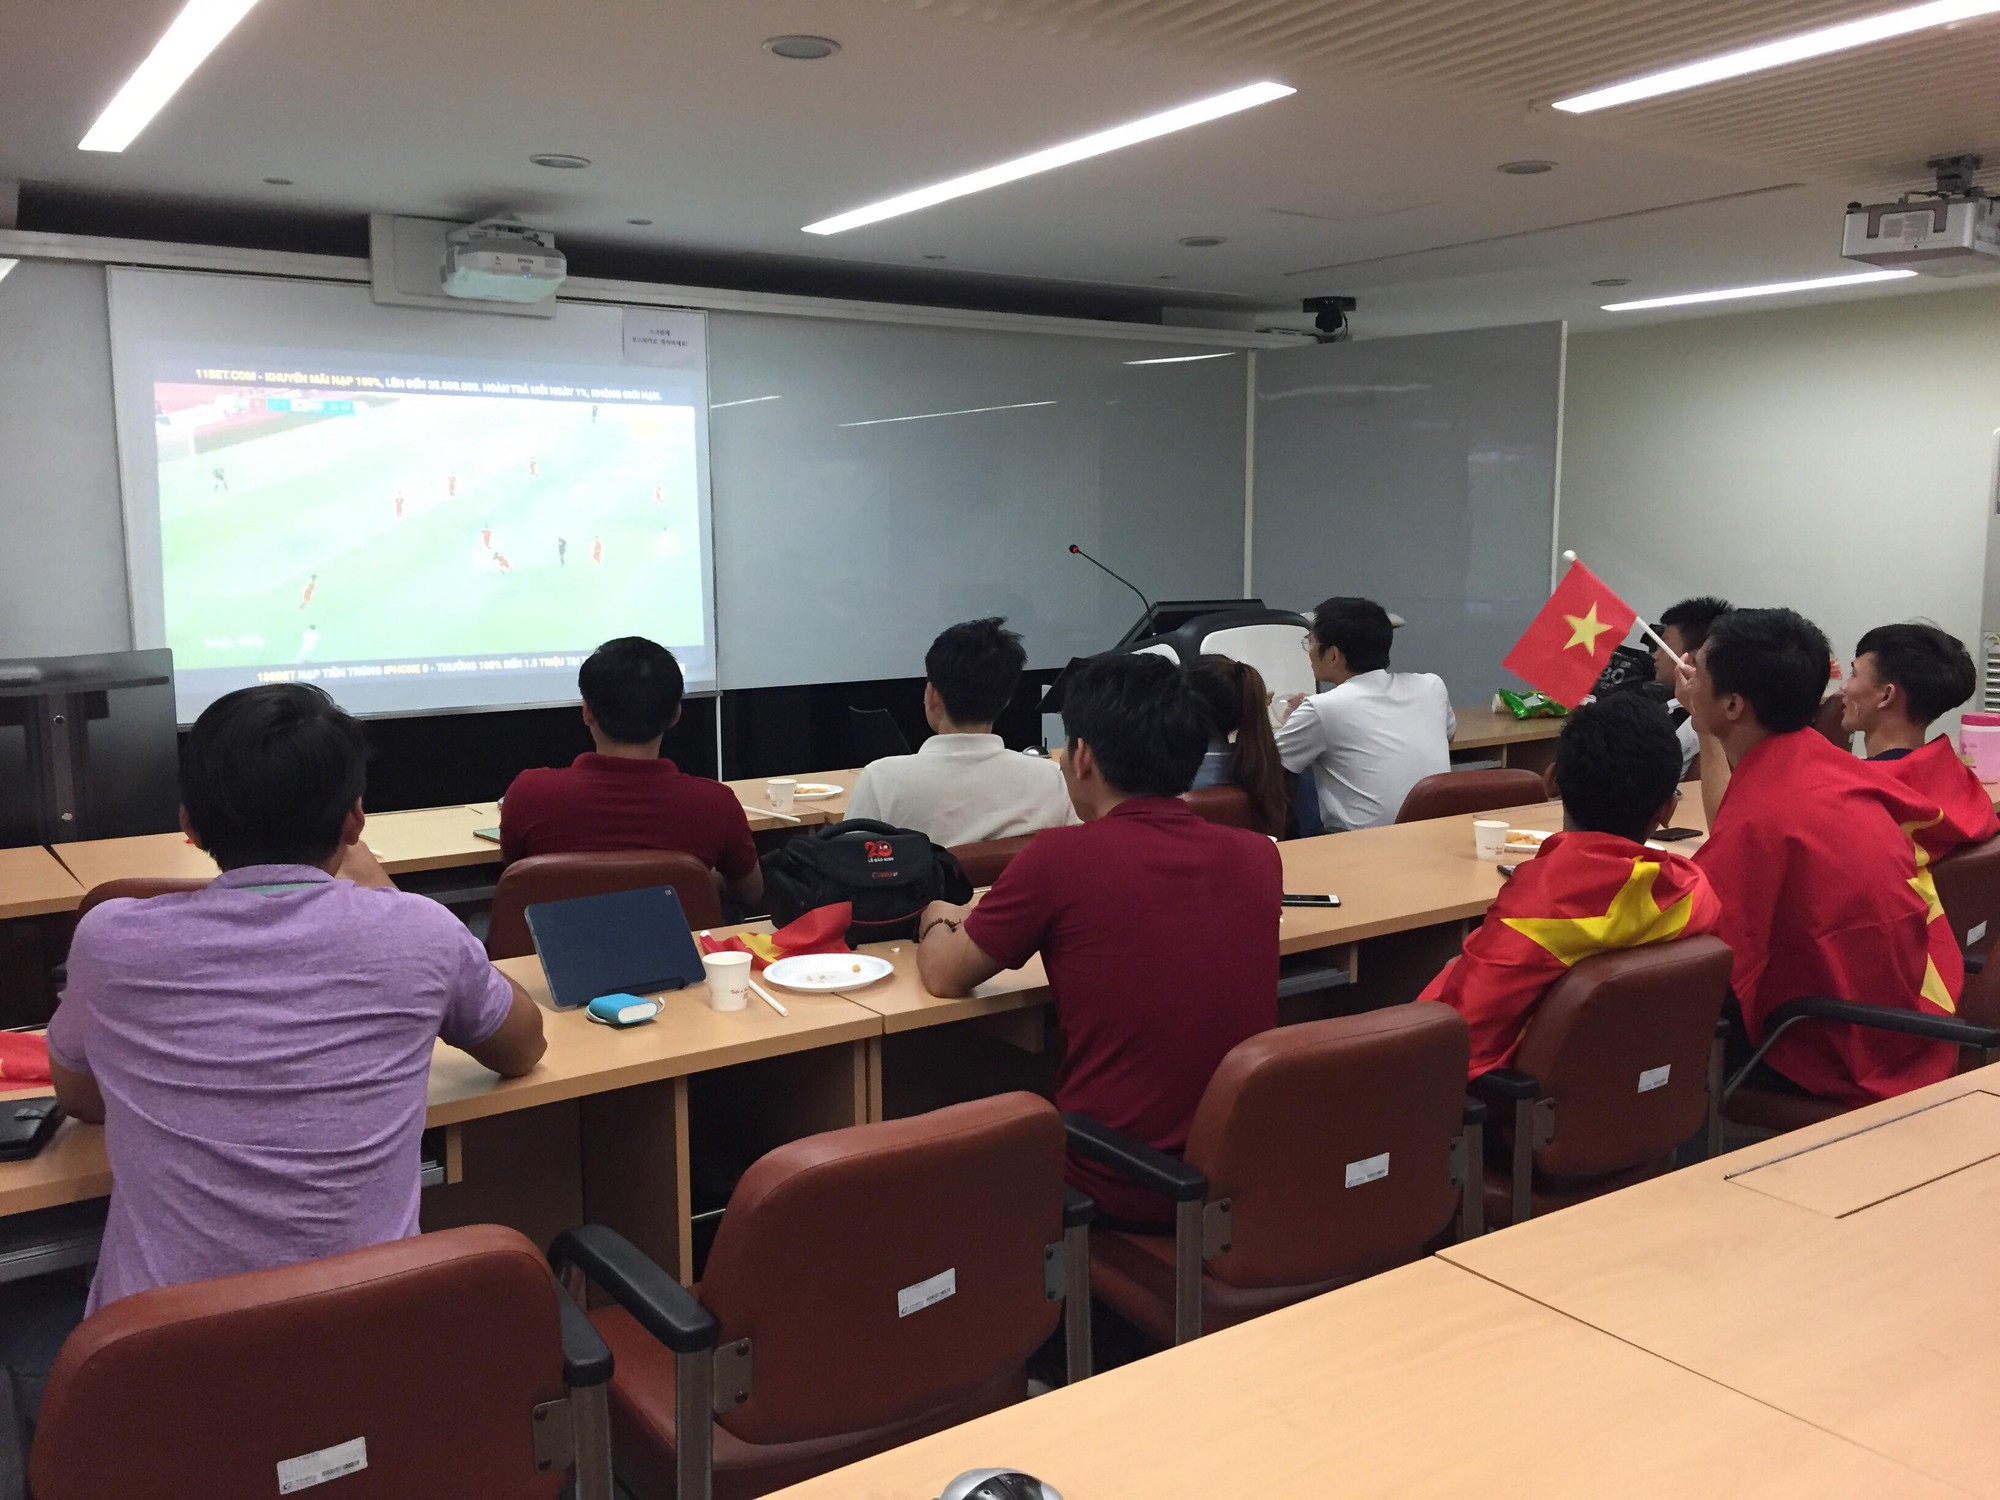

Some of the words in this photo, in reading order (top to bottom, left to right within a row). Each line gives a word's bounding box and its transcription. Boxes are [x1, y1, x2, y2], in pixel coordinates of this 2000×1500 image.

[196, 369, 256, 381] 11BET.COM
[384, 663, 421, 675] IPHONE
[864, 840, 892, 858] 20
